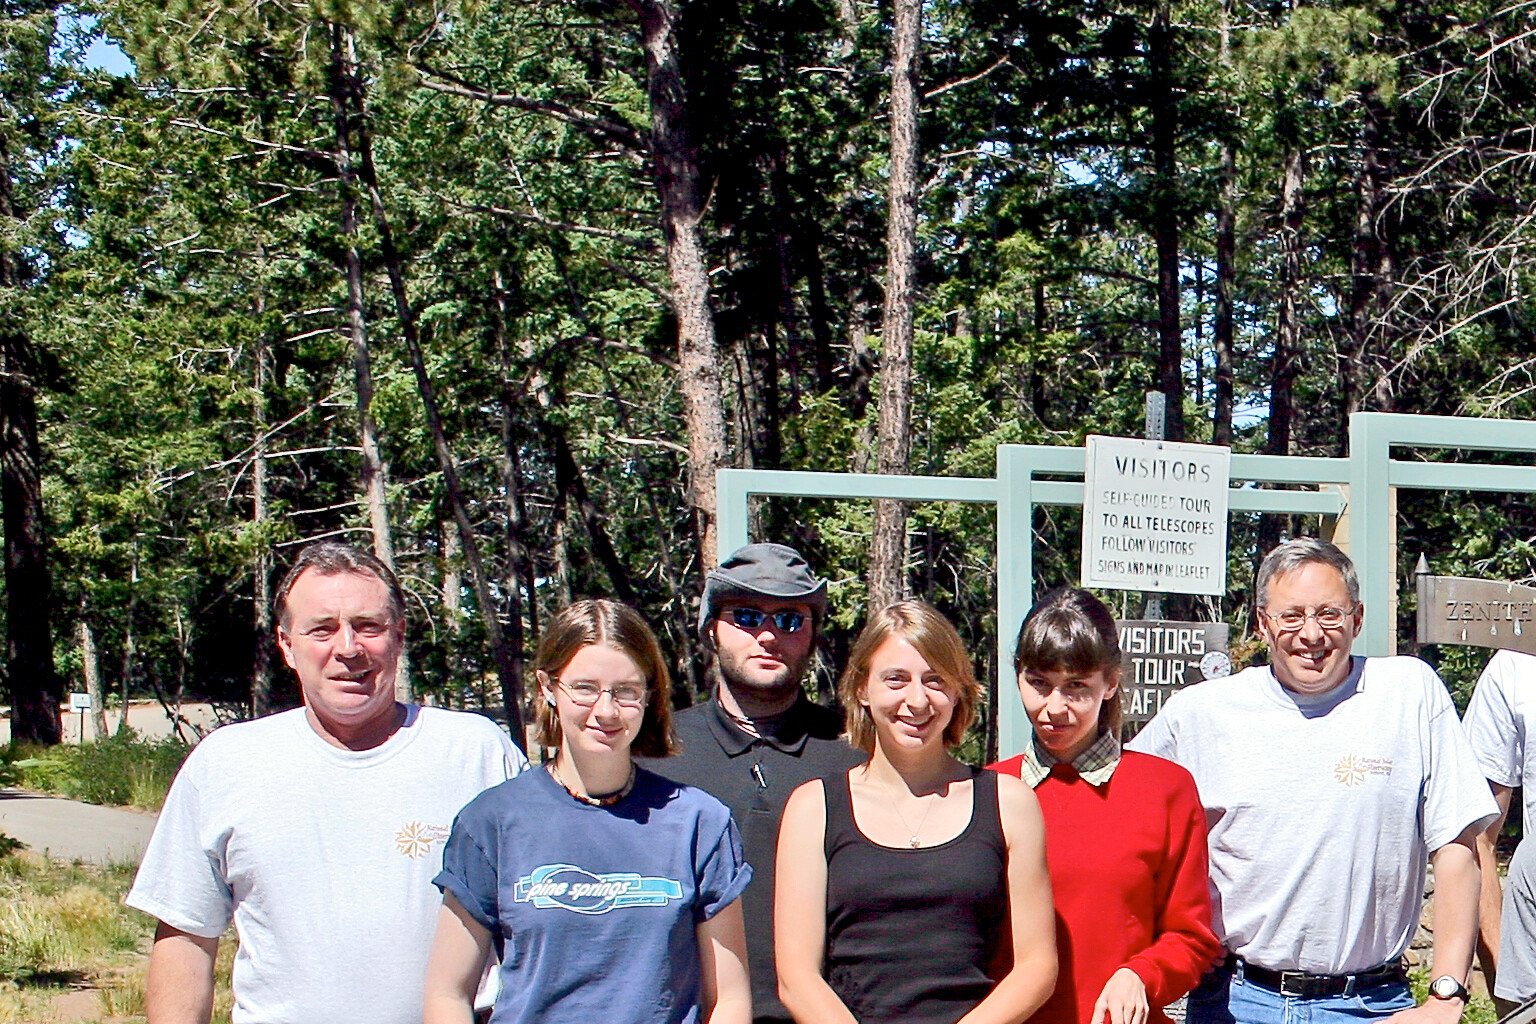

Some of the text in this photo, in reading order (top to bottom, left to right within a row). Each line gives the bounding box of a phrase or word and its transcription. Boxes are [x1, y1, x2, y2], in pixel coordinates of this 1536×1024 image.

[1115, 455, 1211, 483] VISITORS
[1179, 496, 1211, 514] TOUR
[1102, 513, 1215, 535] TO ALL TELESCOPES
[1101, 536, 1146, 552] FOLLOW
[1098, 559, 1125, 574] SIGNS
[1127, 561, 1144, 575] AND
[1145, 562, 1163, 576] MAP
[1174, 565, 1211, 580] LEAFLET
[1445, 599, 1534, 622] ZENITH
[1131, 658, 1186, 685] TOUR
[525, 878, 632, 903] pine springs
